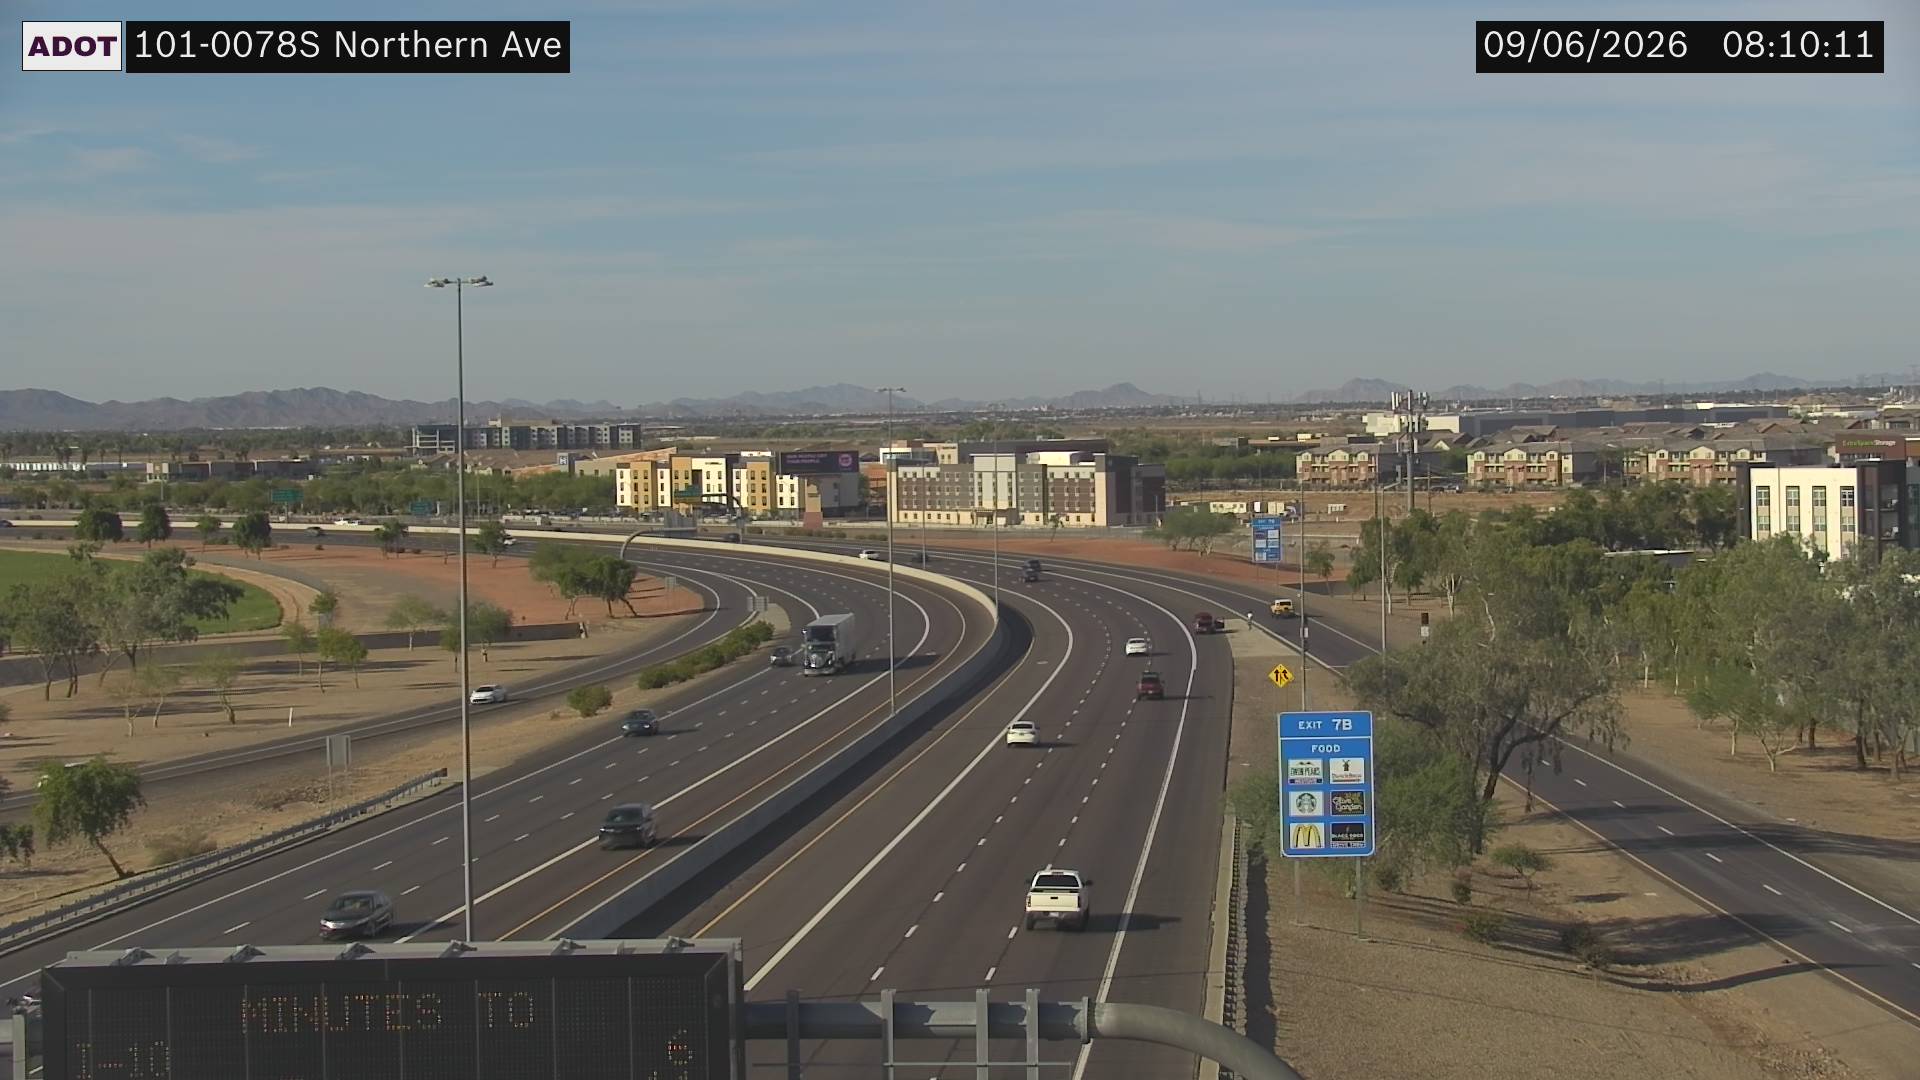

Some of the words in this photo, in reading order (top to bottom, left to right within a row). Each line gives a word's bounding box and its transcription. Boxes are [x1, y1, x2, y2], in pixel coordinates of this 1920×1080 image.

[1298, 721, 1322, 730] EXIT
[1332, 718, 1353, 731] 7B
[1311, 744, 1341, 753] FOOD
[242, 995, 441, 1033] MINUTES
[477, 991, 534, 1028] TO
[76, 1040, 171, 1079] I-10
